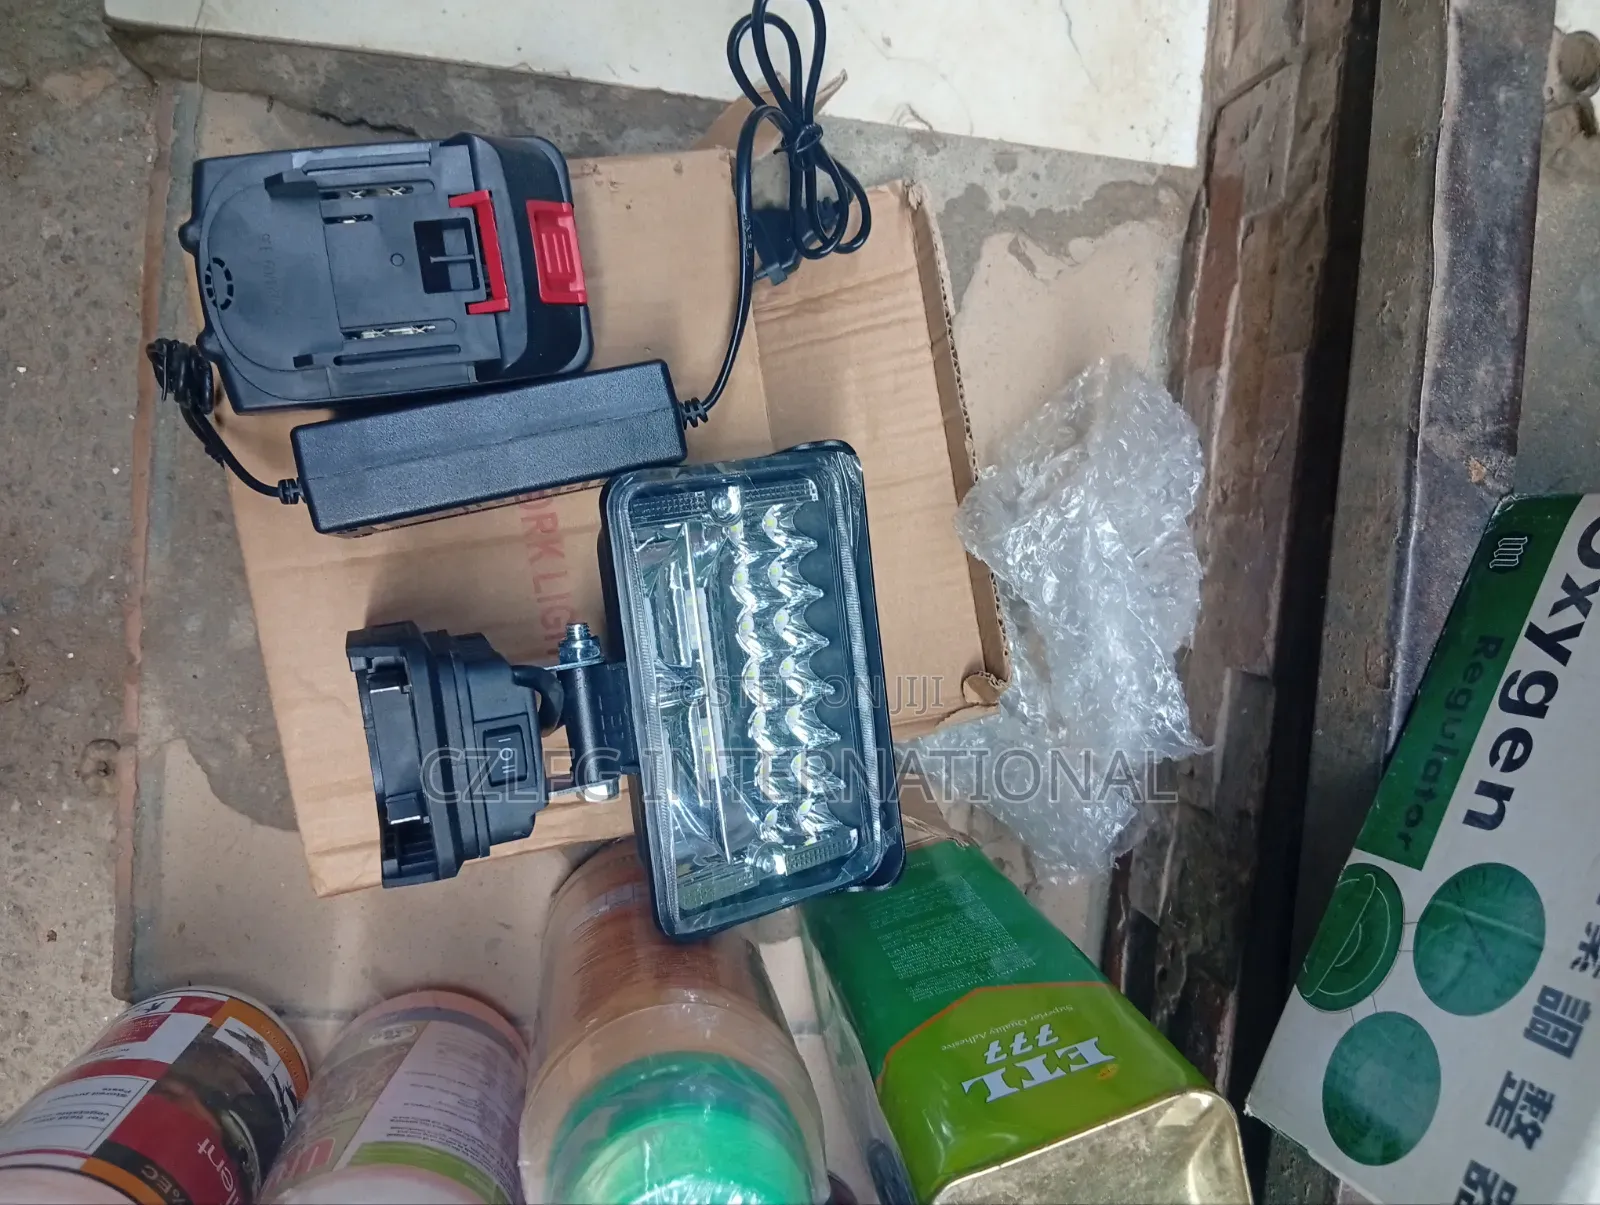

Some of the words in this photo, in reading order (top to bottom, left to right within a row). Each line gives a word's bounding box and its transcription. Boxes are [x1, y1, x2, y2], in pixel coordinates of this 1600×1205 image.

[1397, 635, 1504, 851] Regulator
[989, 1019, 1028, 1036] Quality
[1030, 1003, 1074, 1022] Superior
[941, 1031, 987, 1051] Adhesive
[984, 1023, 1059, 1065] 777
[961, 1036, 1116, 1103] ETL
